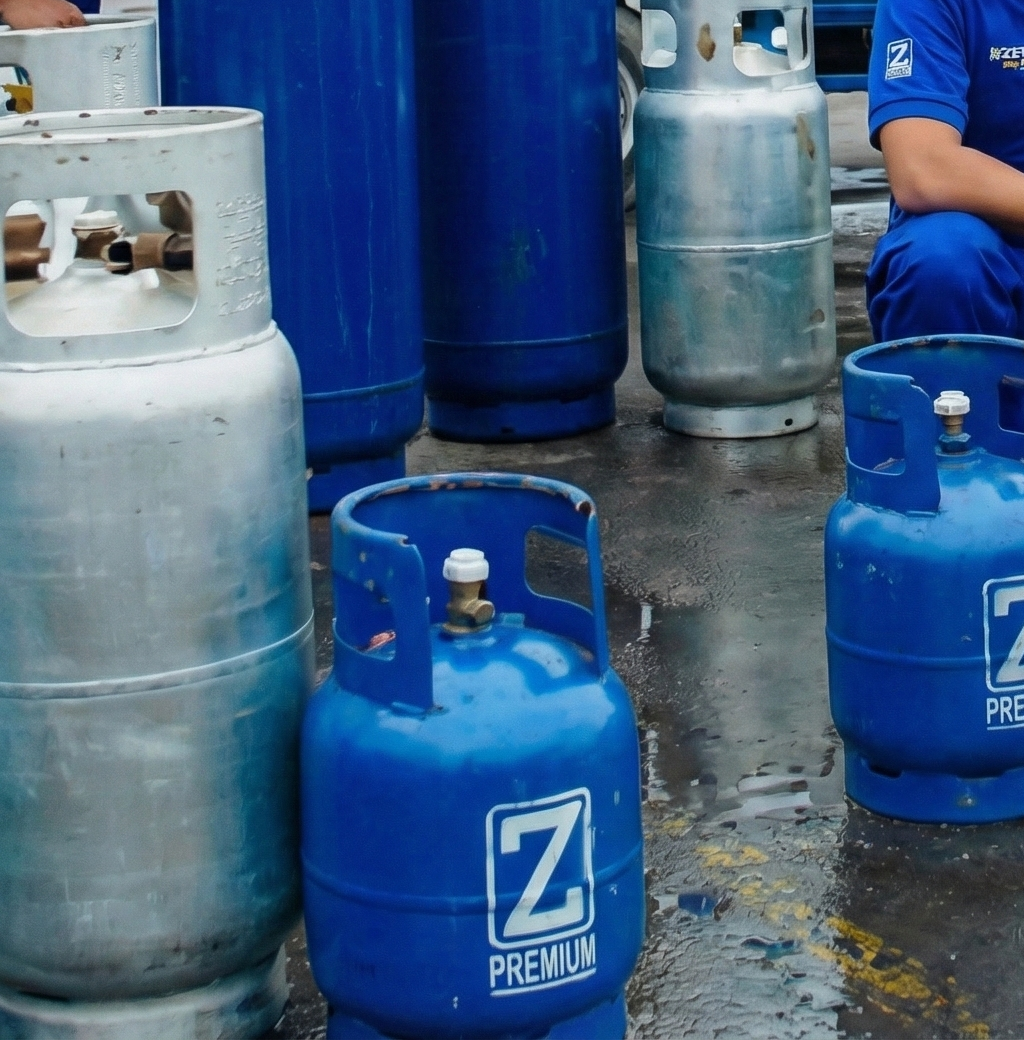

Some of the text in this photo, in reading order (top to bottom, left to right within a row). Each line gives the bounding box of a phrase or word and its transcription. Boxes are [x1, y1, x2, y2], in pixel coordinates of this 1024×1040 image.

[890, 43, 909, 67] Z
[501, 800, 583, 937] Z
[490, 933, 596, 988] PREMIUM
